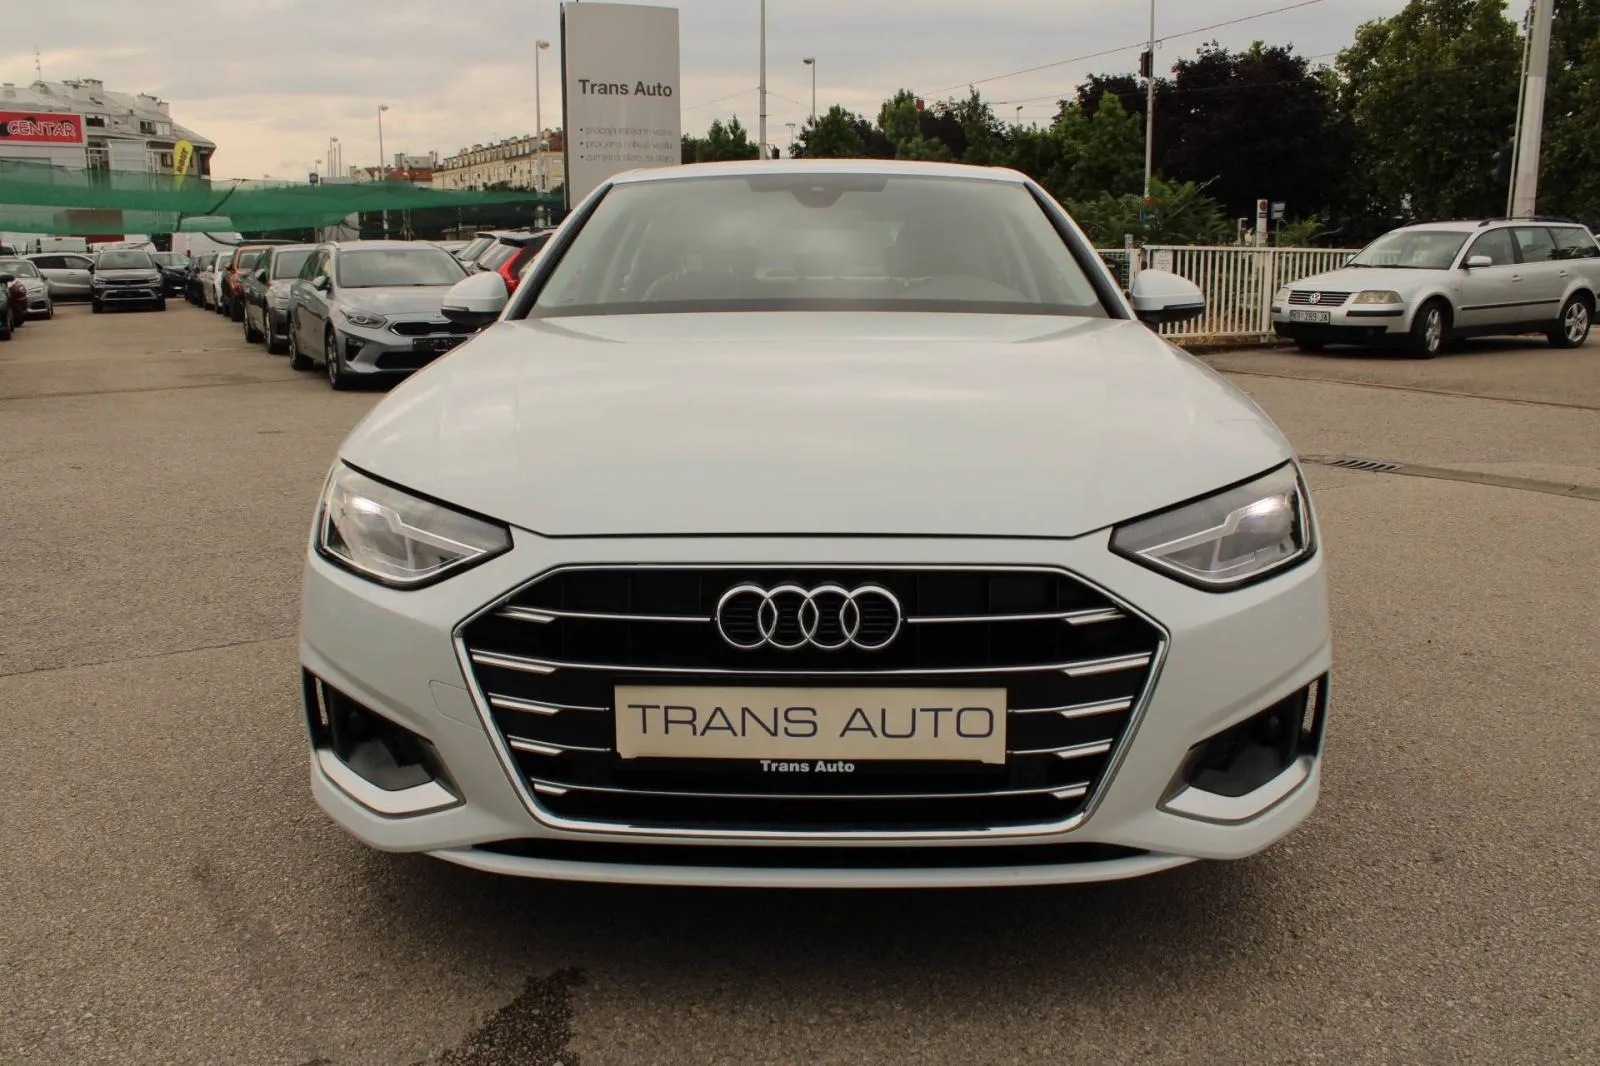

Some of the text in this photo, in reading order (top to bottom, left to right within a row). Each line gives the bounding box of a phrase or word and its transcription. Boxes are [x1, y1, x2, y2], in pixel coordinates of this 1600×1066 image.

[578, 79, 672, 97] Trans Auto
[7, 120, 76, 137] CENTAR
[627, 704, 994, 739] TRANS AUTO
[760, 760, 855, 773] Trans Auto
